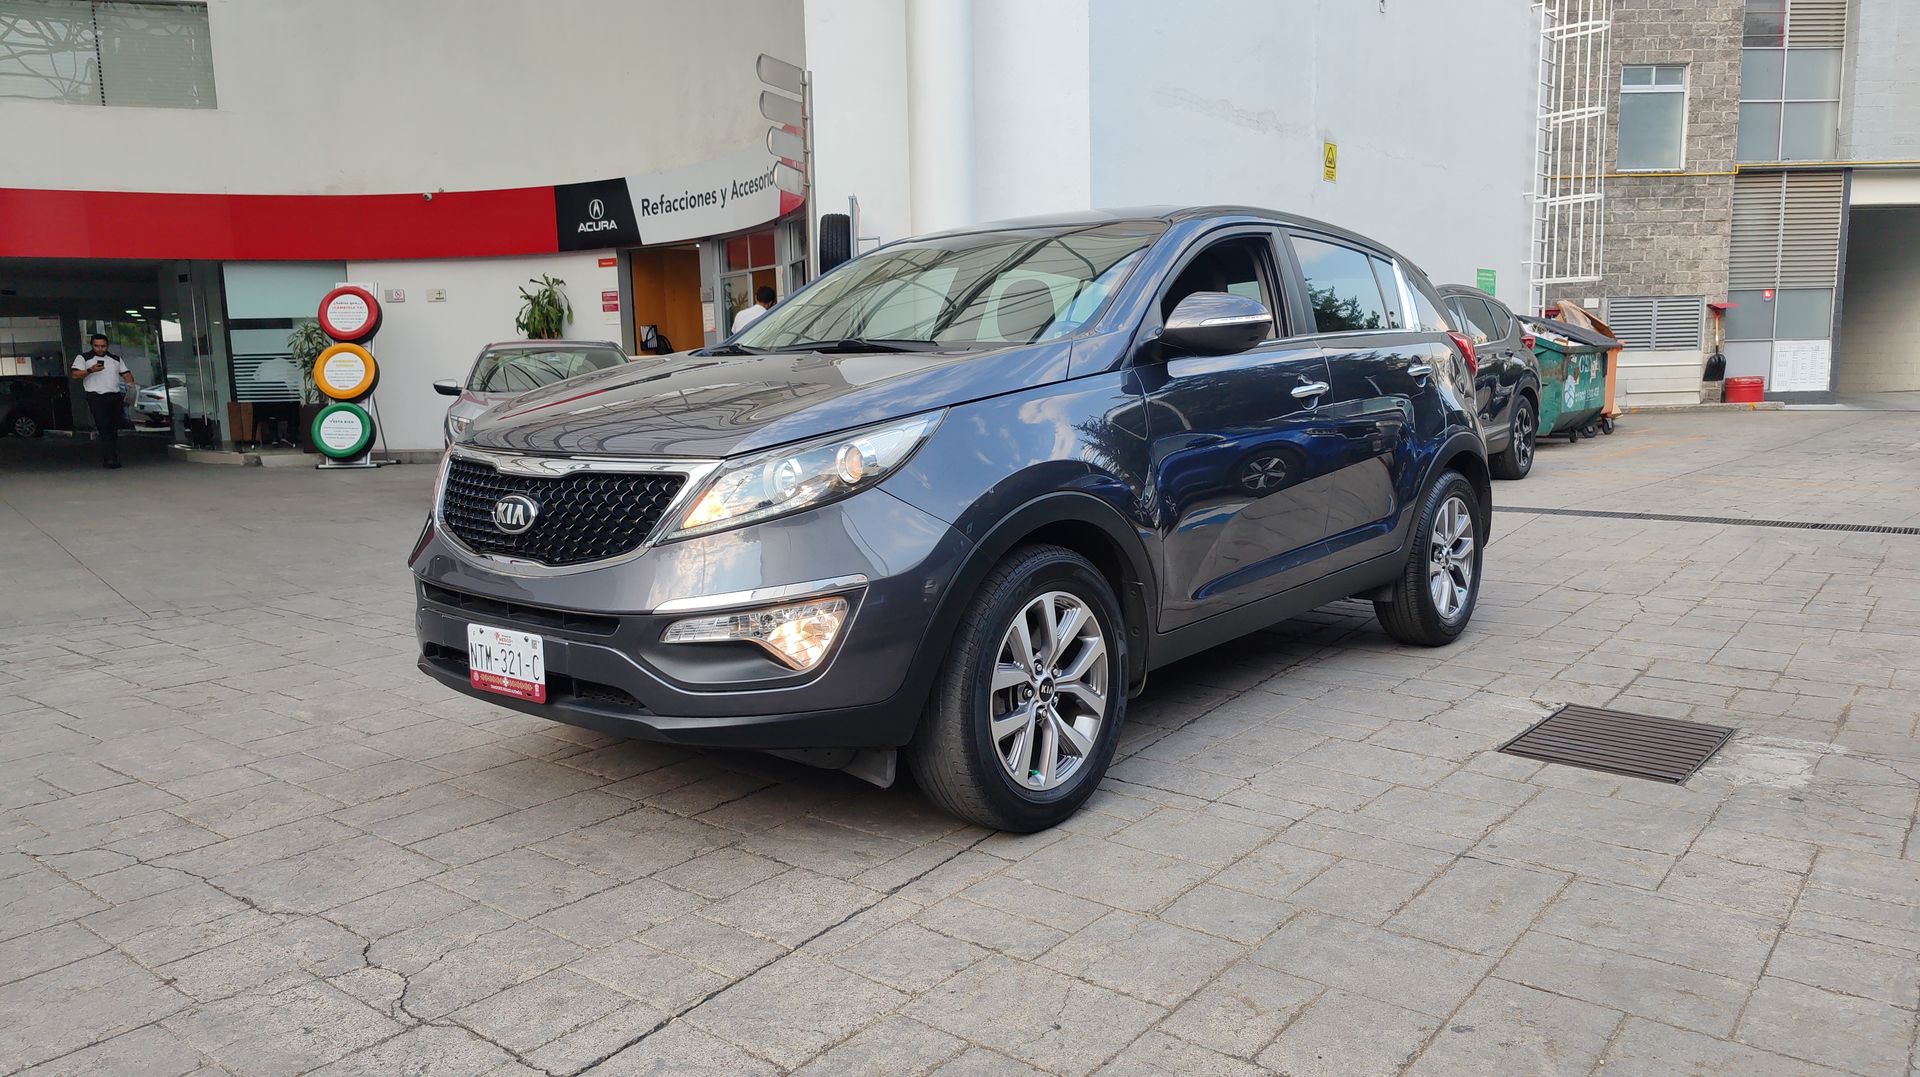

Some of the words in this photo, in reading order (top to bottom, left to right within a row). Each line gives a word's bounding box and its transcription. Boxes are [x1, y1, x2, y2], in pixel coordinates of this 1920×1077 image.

[641, 190, 718, 217] Refacciones
[720, 187, 728, 209] y
[730, 165, 774, 201] Accesorio
[578, 220, 617, 232] ACURA
[496, 502, 526, 526] KIA
[470, 642, 540, 681] NTM-321-C
[1041, 685, 1053, 694] KIA
